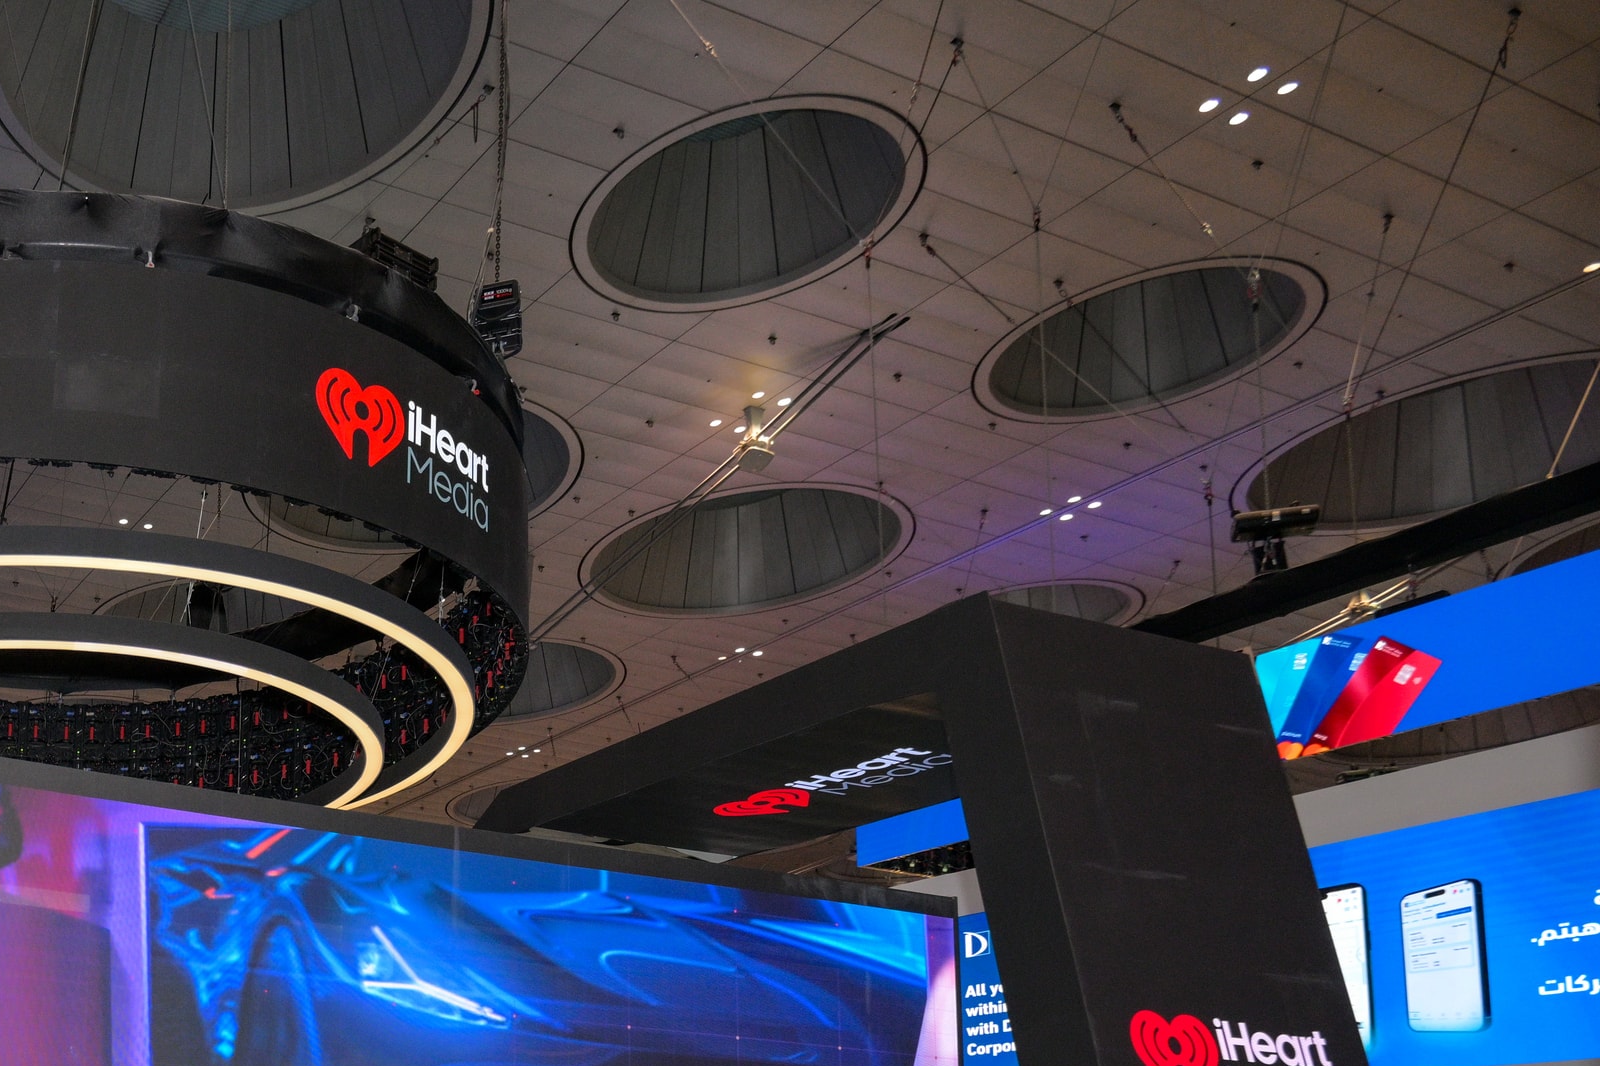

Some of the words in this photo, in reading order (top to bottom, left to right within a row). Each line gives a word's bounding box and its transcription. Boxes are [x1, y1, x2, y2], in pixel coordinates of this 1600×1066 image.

[407, 400, 489, 493] iHeart
[406, 446, 489, 533] Media
[784, 747, 932, 791] iHeart
[965, 983, 987, 998] All
[966, 1021, 999, 1037] with
